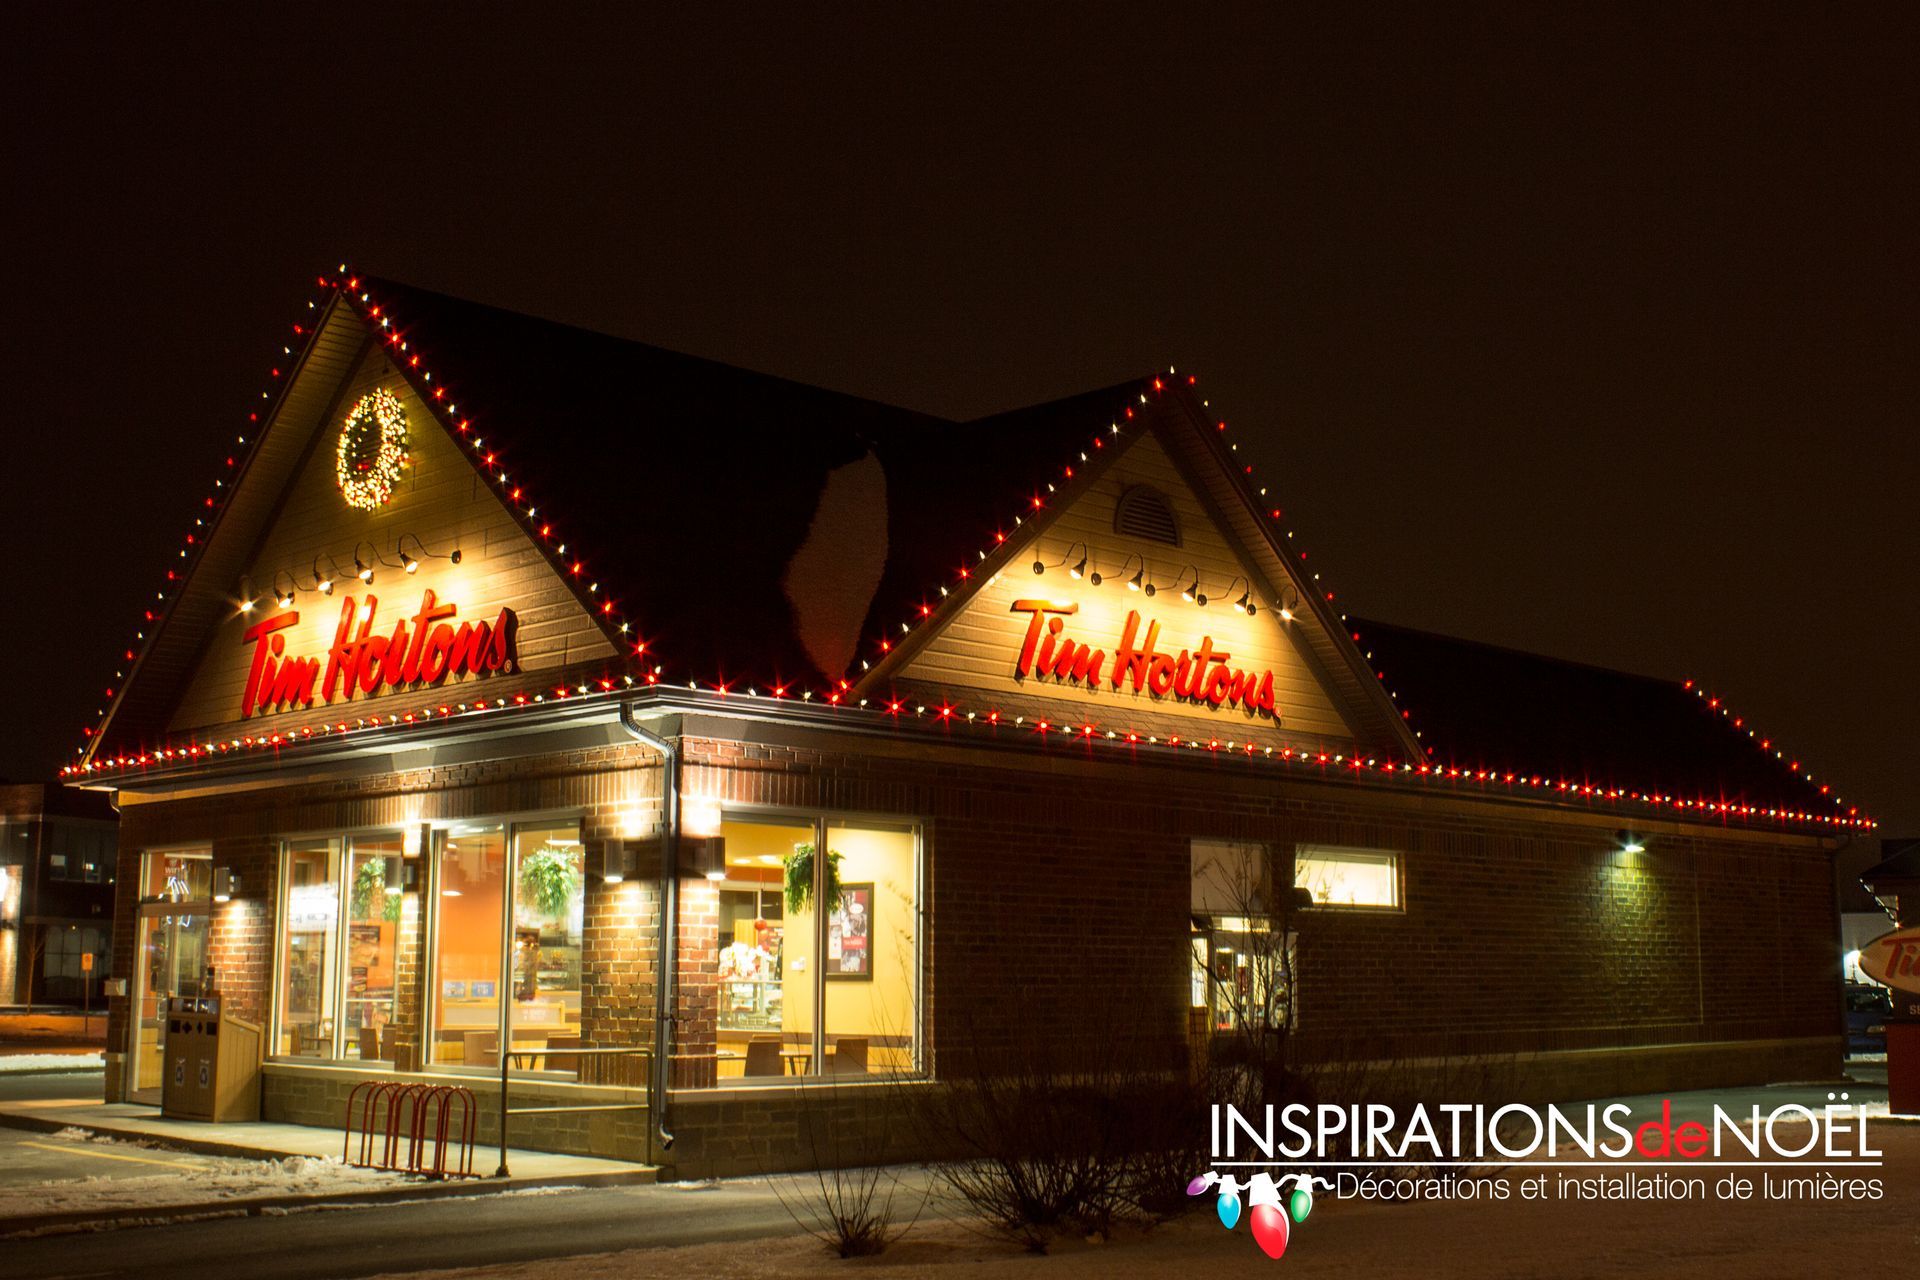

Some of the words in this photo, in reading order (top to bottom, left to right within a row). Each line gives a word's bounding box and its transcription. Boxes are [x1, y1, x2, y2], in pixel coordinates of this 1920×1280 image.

[242, 611, 320, 717] Tim
[322, 589, 507, 701] Hortons
[1011, 600, 1105, 686] Tim
[1111, 610, 1276, 710] Hortons
[1881, 937, 1920, 978] Ti
